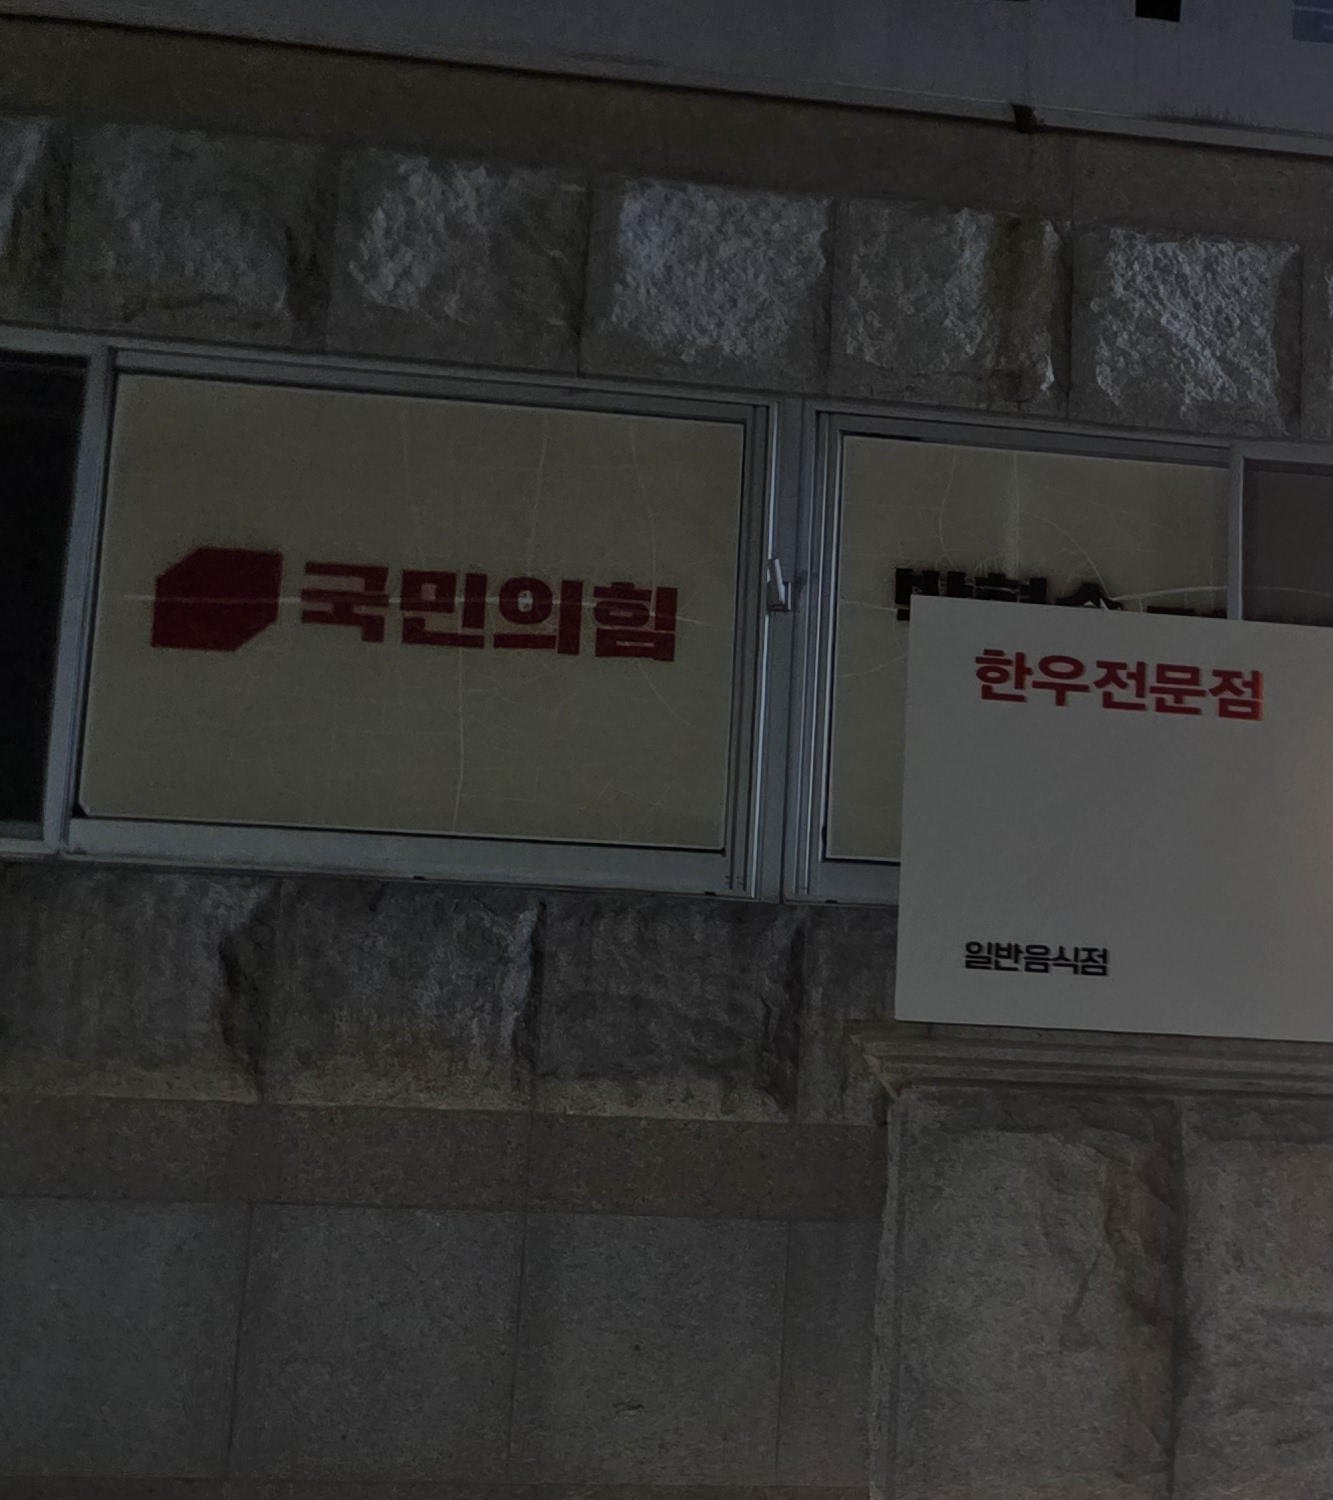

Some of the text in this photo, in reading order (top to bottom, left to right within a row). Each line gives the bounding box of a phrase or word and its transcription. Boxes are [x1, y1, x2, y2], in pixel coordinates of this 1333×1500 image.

[300, 561, 679, 662] 국민의힘
[975, 649, 1264, 721] 한우전문점
[964, 941, 1109, 976] 일반음식점
